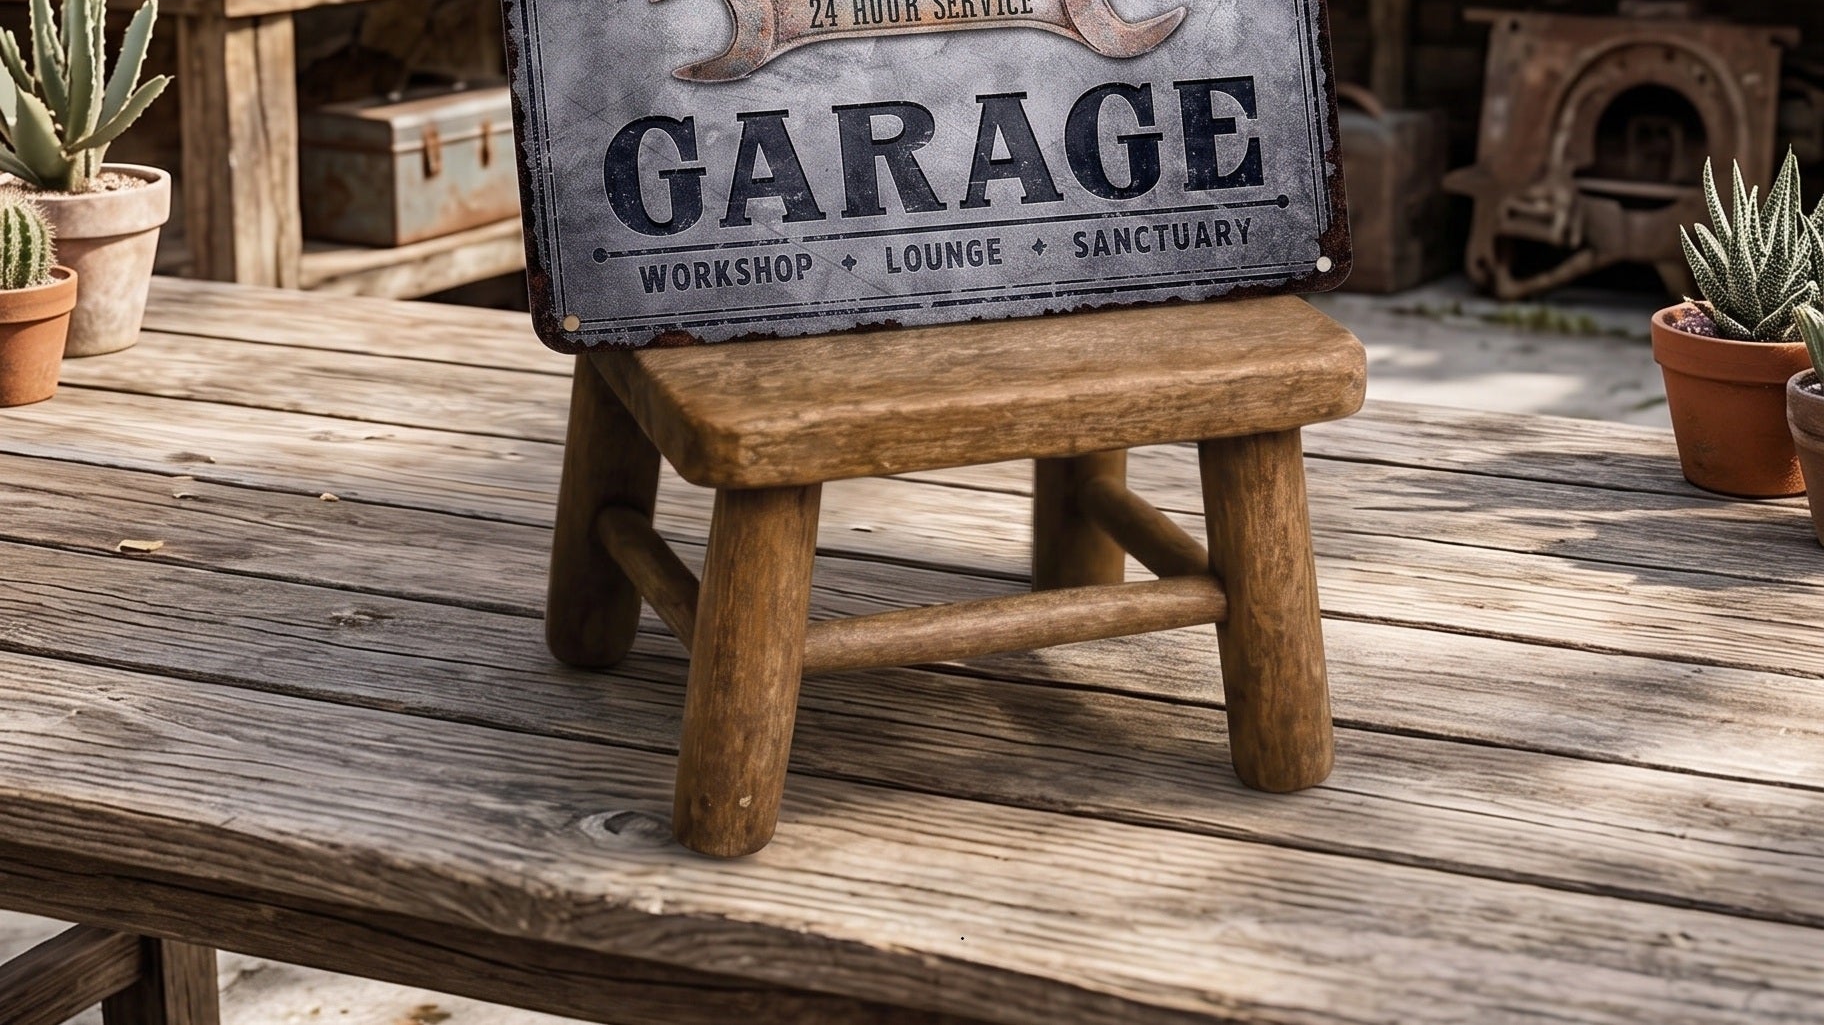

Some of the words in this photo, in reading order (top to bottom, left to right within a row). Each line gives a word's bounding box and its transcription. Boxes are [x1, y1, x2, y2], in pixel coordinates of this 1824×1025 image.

[604, 75, 1265, 237] GARAGE
[639, 252, 814, 293] WORKSHOP
[885, 237, 1003, 274] LOUNGE
[1072, 217, 1253, 260] SANCTUARY
